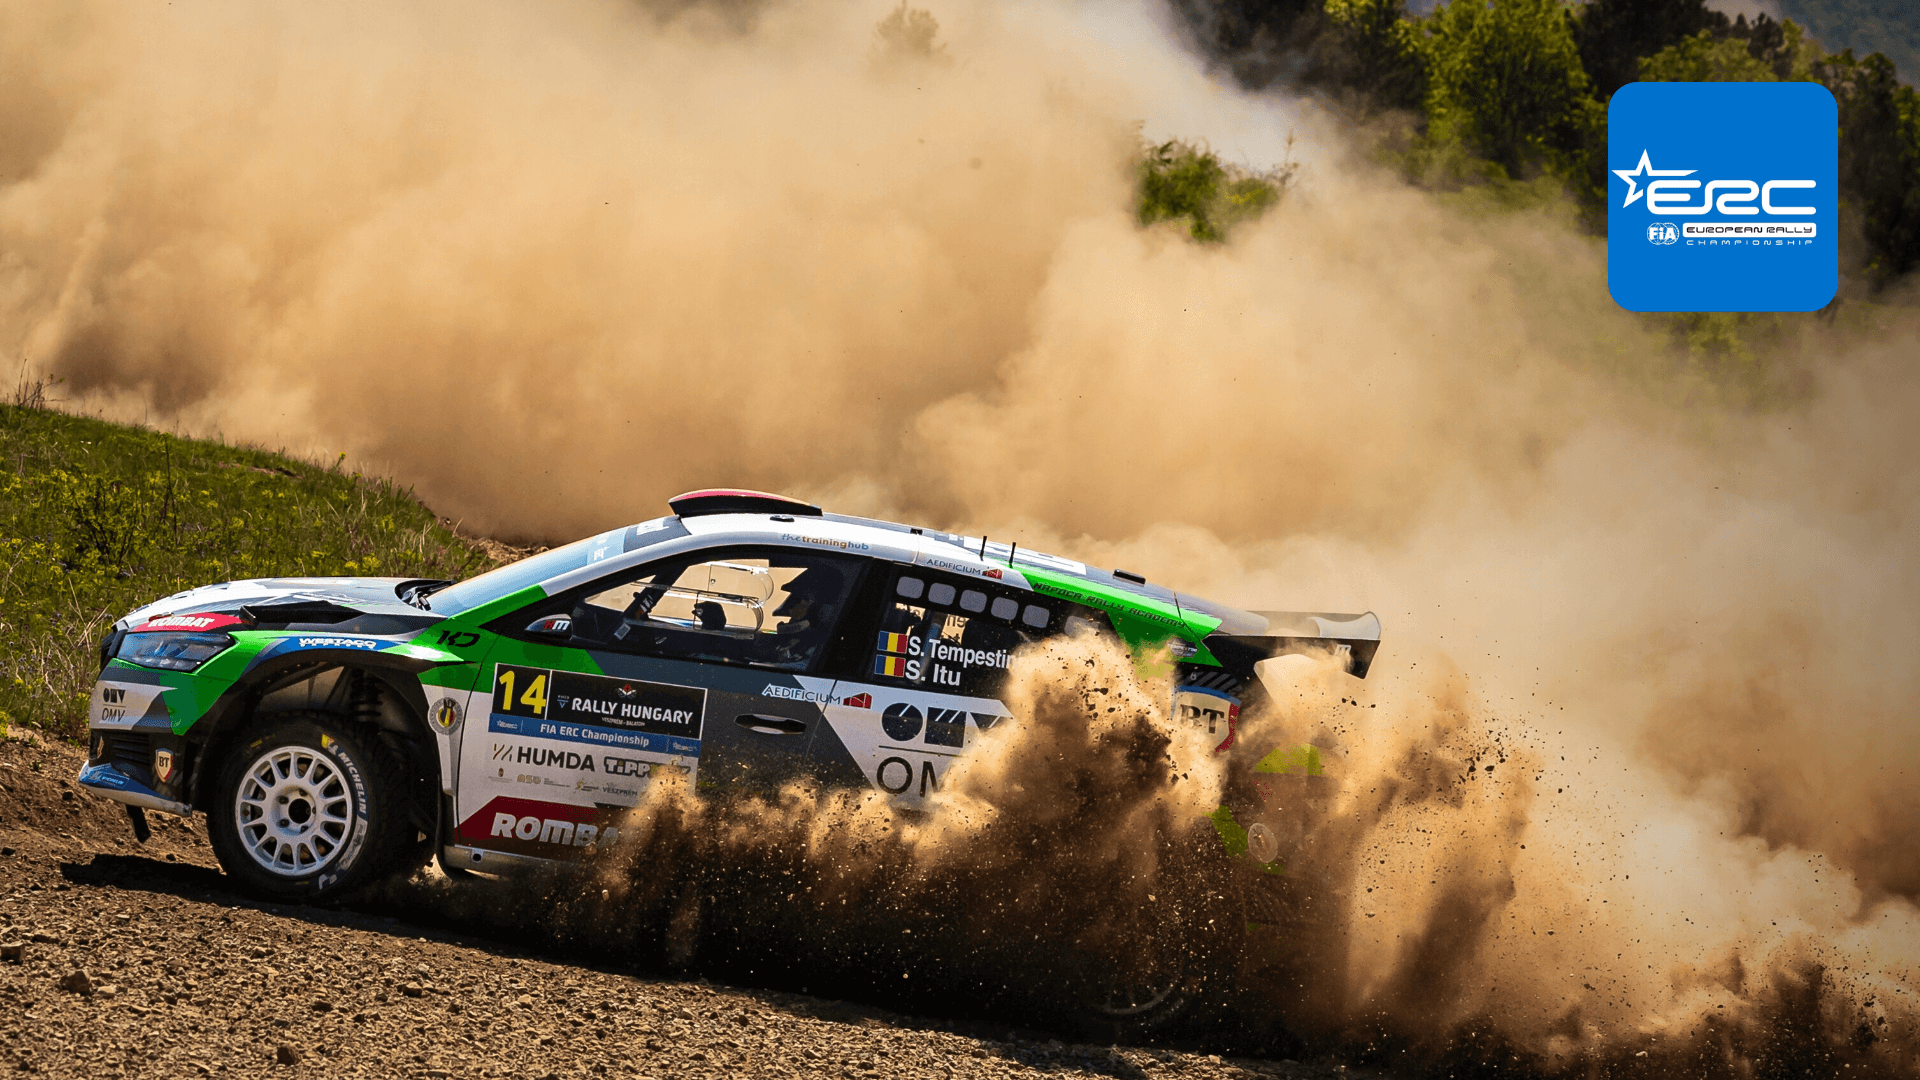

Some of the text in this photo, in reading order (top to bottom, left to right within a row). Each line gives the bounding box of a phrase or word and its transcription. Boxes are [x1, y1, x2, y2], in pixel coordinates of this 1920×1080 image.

[926, 558, 981, 576] AEDIFICIUM
[907, 635, 925, 657] S.
[905, 659, 961, 686] S. Itu
[498, 670, 547, 715] 14
[762, 684, 841, 706] AEDIFICIUM
[101, 707, 126, 722] OMV
[571, 697, 694, 724] RALLY HUNGARY
[540, 723, 650, 748] FIA ERC Championship
[158, 756, 170, 768] BT
[516, 746, 595, 772] HUMDA
[338, 752, 368, 815] MICHELIN
